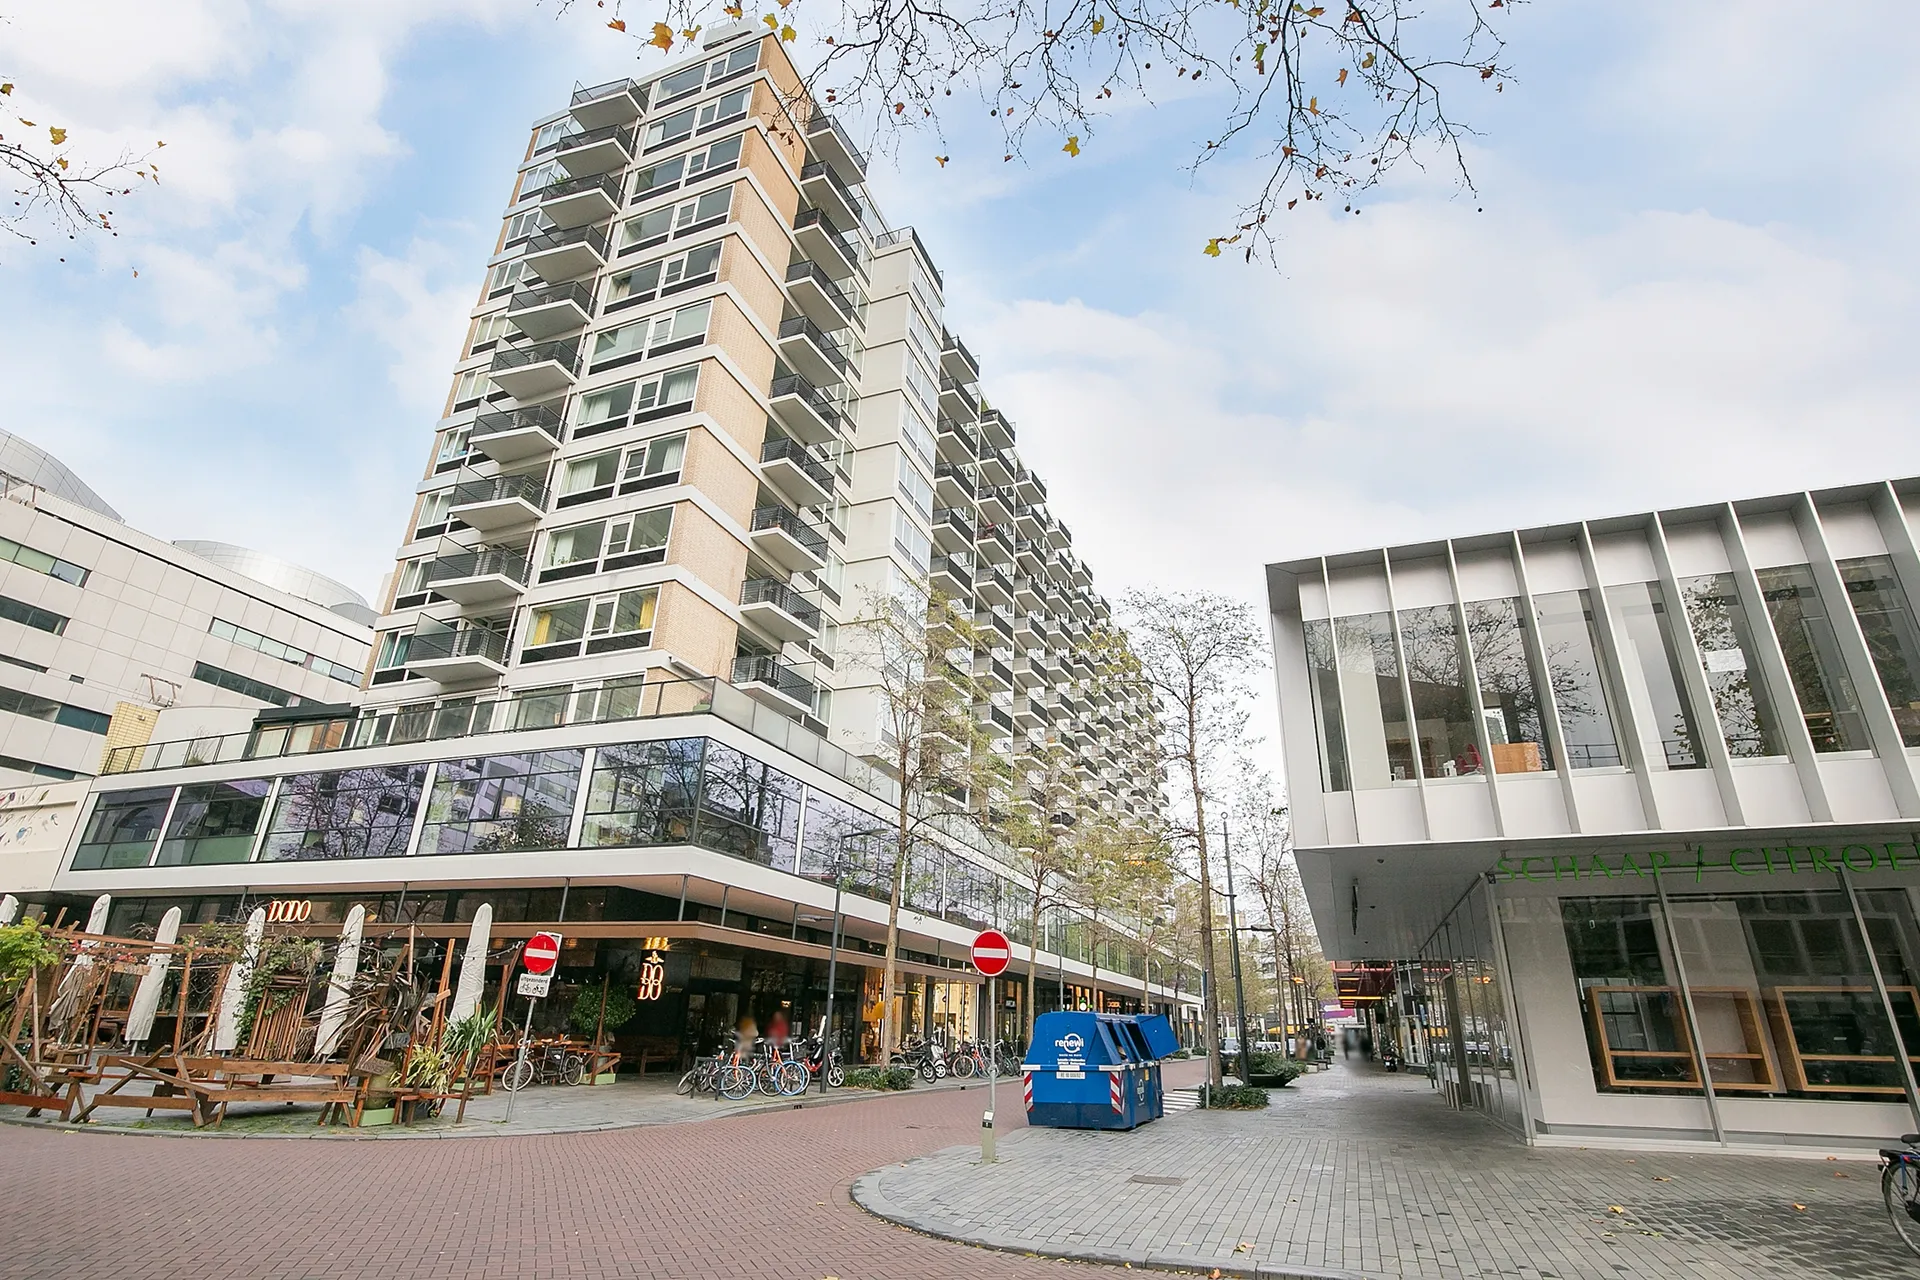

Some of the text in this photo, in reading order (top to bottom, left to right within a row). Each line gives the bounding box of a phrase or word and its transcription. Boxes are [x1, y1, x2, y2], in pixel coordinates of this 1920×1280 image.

[1496, 853, 1670, 882] SCHAAP
[1729, 842, 1920, 876] CITROE
[266, 900, 312, 922] DODO
[520, 976, 549, 984] uitgezonderd
[1054, 1038, 1084, 1048] renewi
